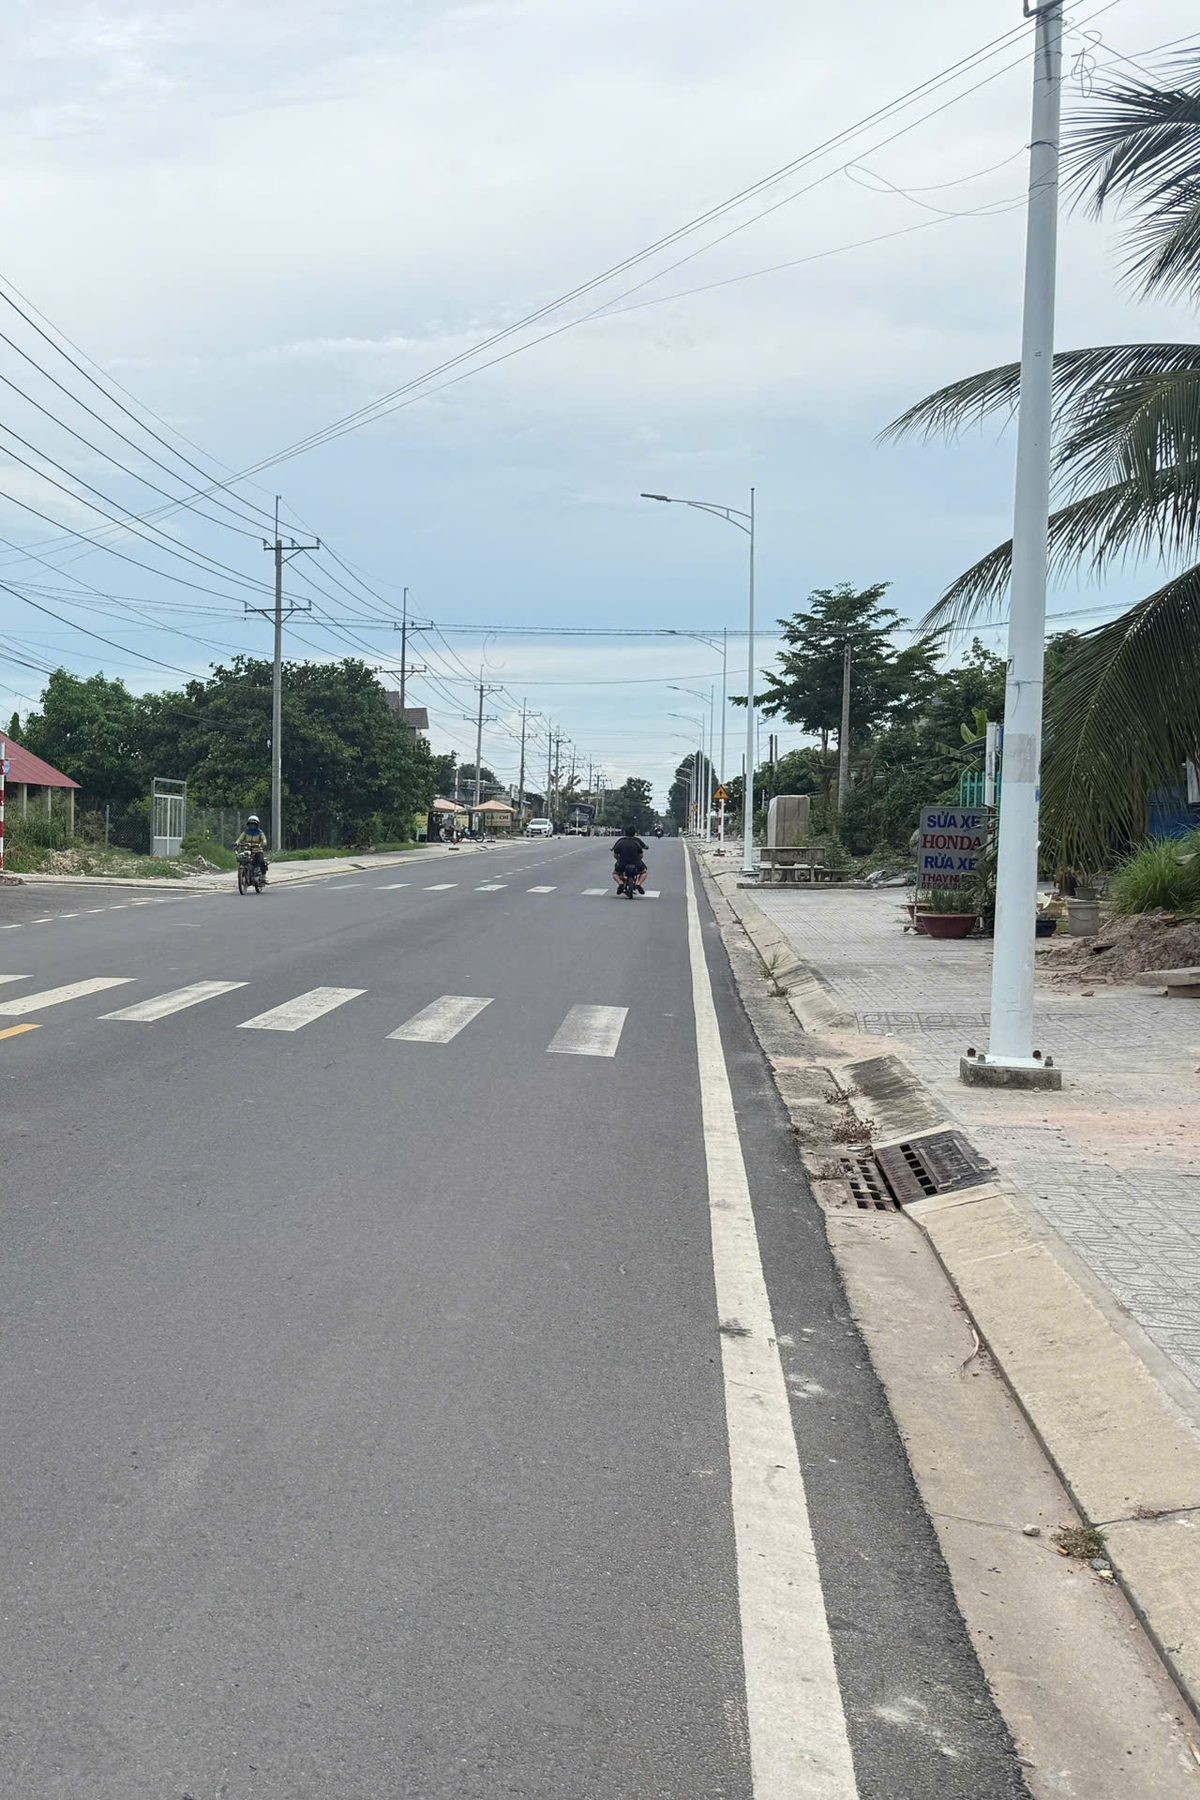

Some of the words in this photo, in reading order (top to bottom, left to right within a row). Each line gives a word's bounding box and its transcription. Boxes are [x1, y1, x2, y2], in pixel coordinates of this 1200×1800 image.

[927, 811, 957, 828] SỬA
[960, 815, 981, 829] XE
[921, 834, 982, 851] HONDA
[924, 852, 954, 869] RỬA
[957, 857, 978, 871] XE
